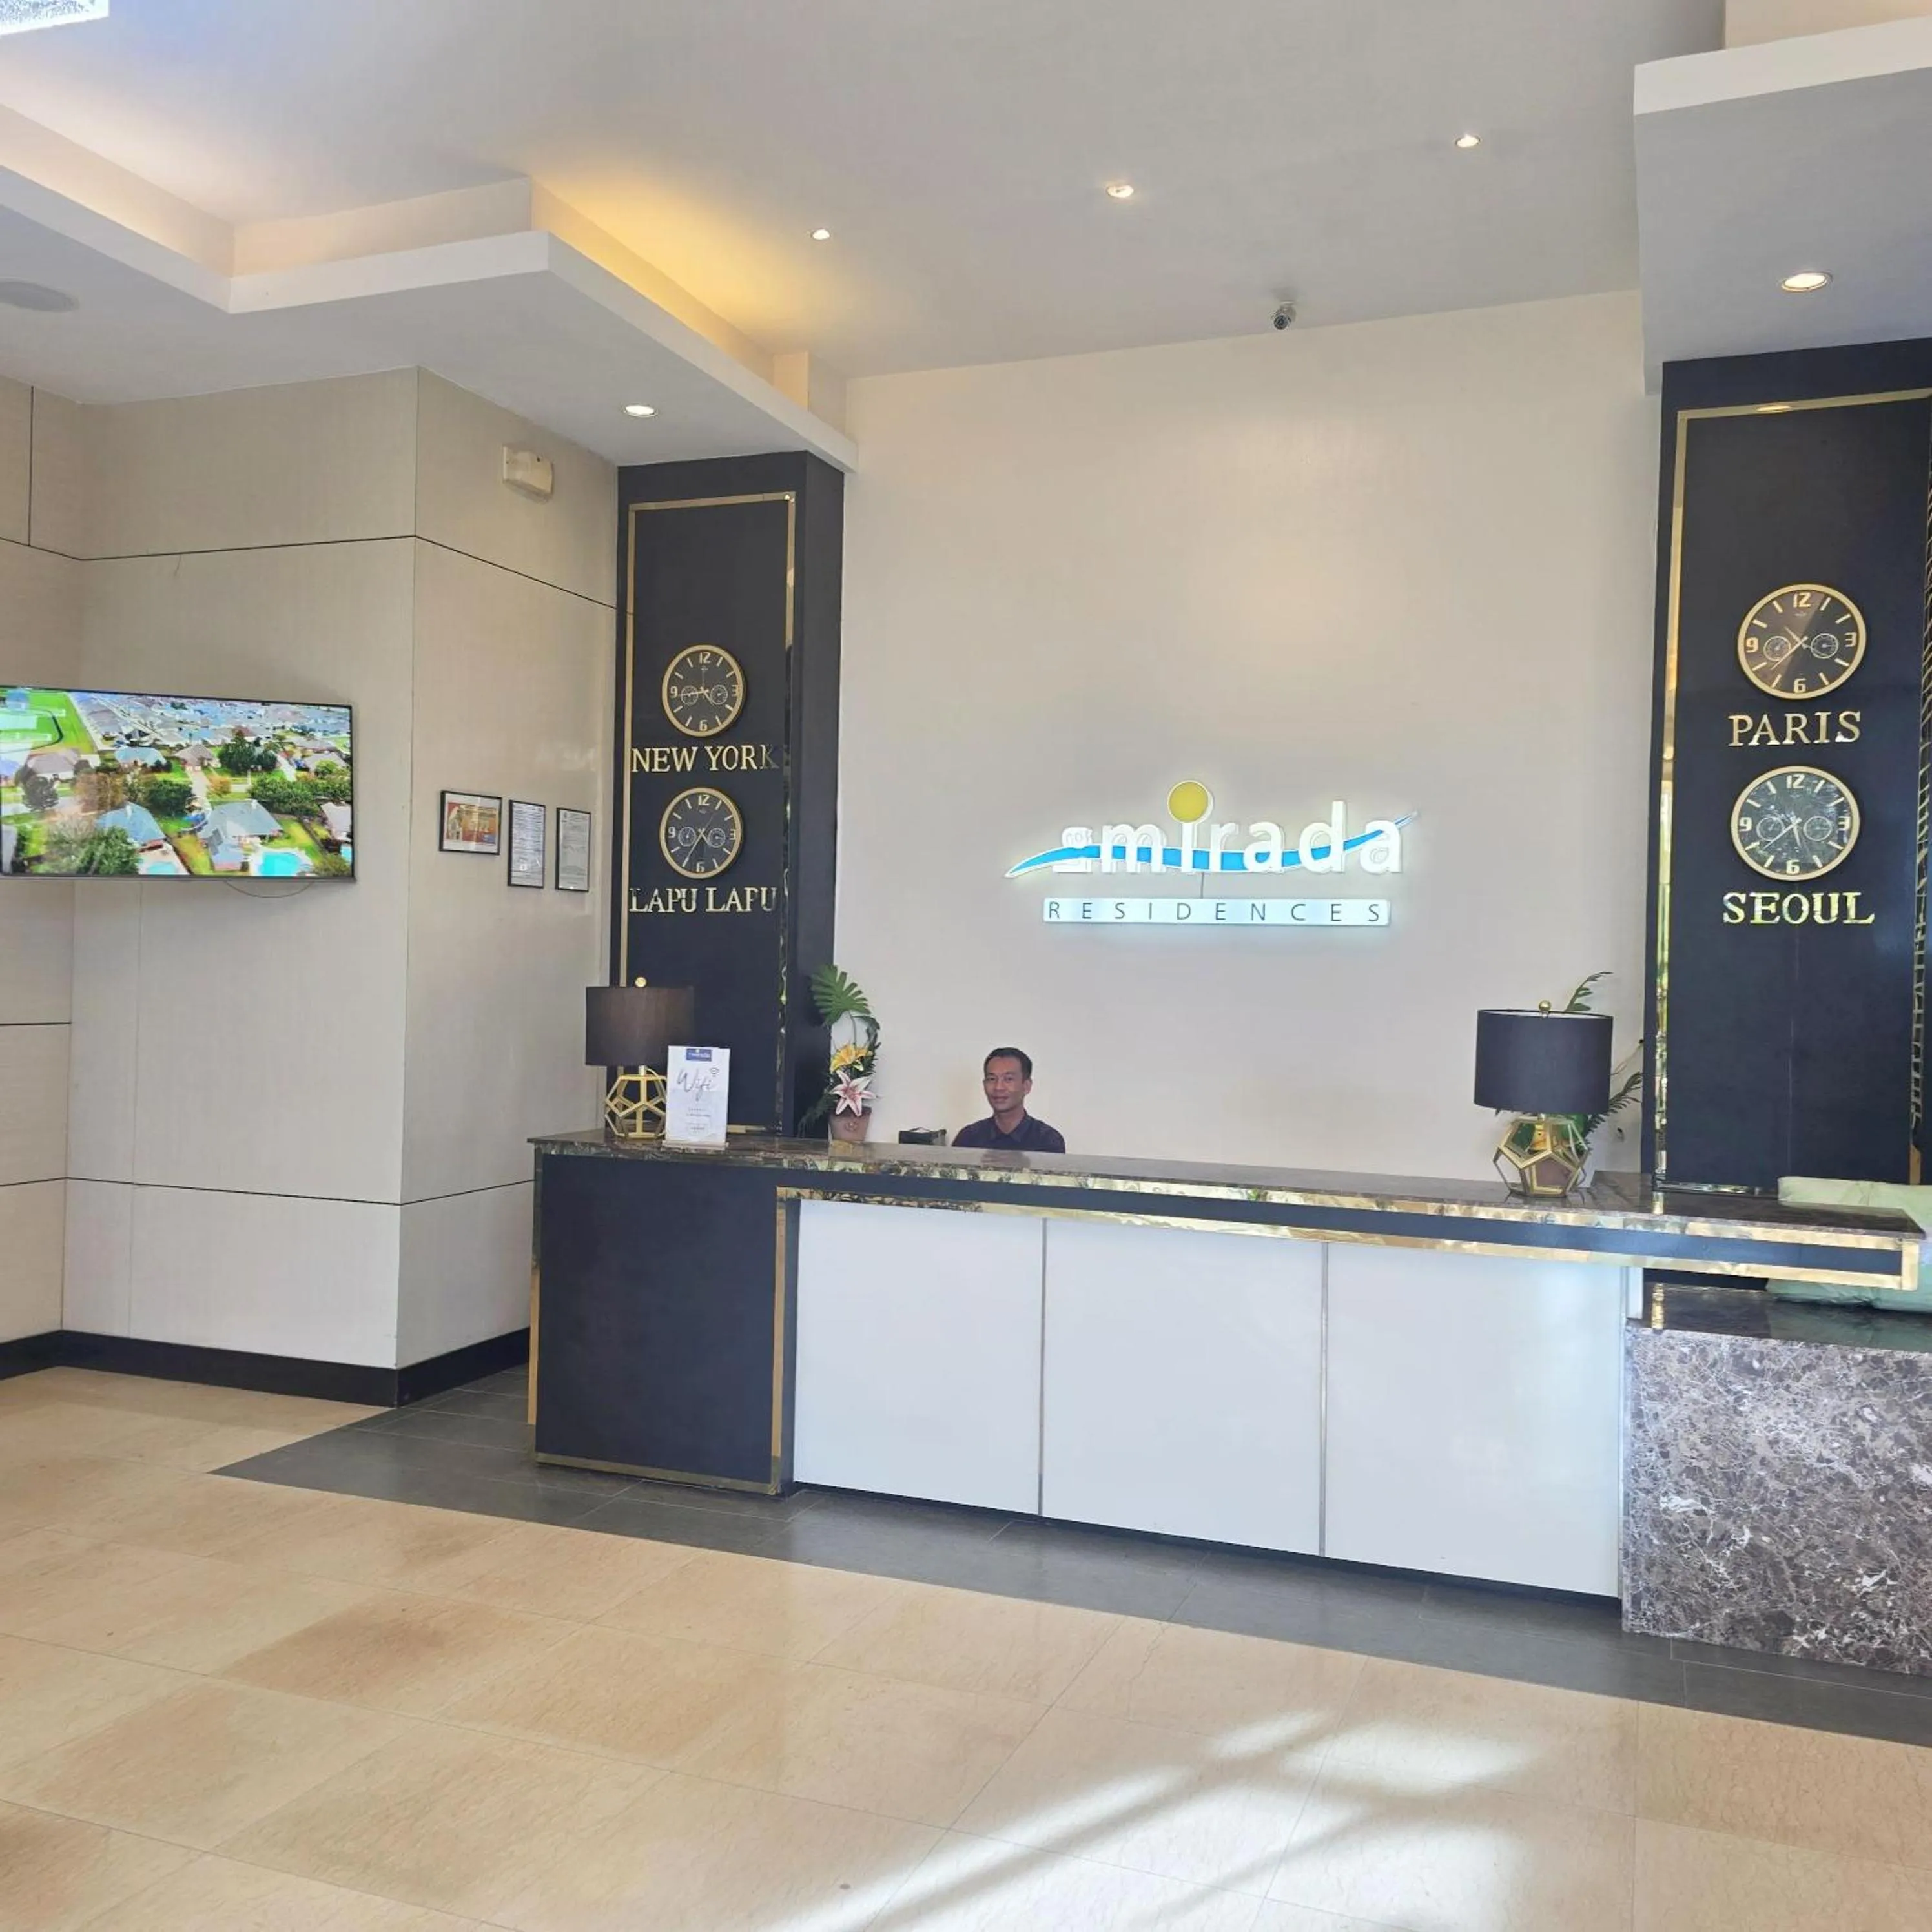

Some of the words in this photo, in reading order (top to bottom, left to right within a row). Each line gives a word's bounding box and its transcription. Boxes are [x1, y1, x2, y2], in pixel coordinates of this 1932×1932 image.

[1793, 593, 1811, 608] 12
[1746, 637, 1759, 652] 9
[1845, 632, 1857, 647] 3
[699, 652, 710, 664] 12
[670, 686, 678, 697] 9
[731, 684, 739, 697] 3
[1793, 679, 1807, 694] 6
[699, 720, 708, 732] 6
[1728, 711, 1861, 746] PARIS
[631, 746, 699, 773] NEW
[704, 743, 780, 771] YORK
[1786, 774, 1805, 789] 12
[698, 794, 710, 806] 12
[1739, 817, 1752, 831] 9
[1838, 816, 1851, 831] 3
[668, 827, 677, 838] 9
[729, 829, 737, 840] 3
[697, 861, 705, 872] 6
[1786, 860, 1800, 874] 6
[630, 888, 698, 912] LAPU
[705, 887, 777, 912] LAPU
[1049, 901, 1380, 922] RESIDENCES
[1723, 892, 1875, 925] SEOUL
